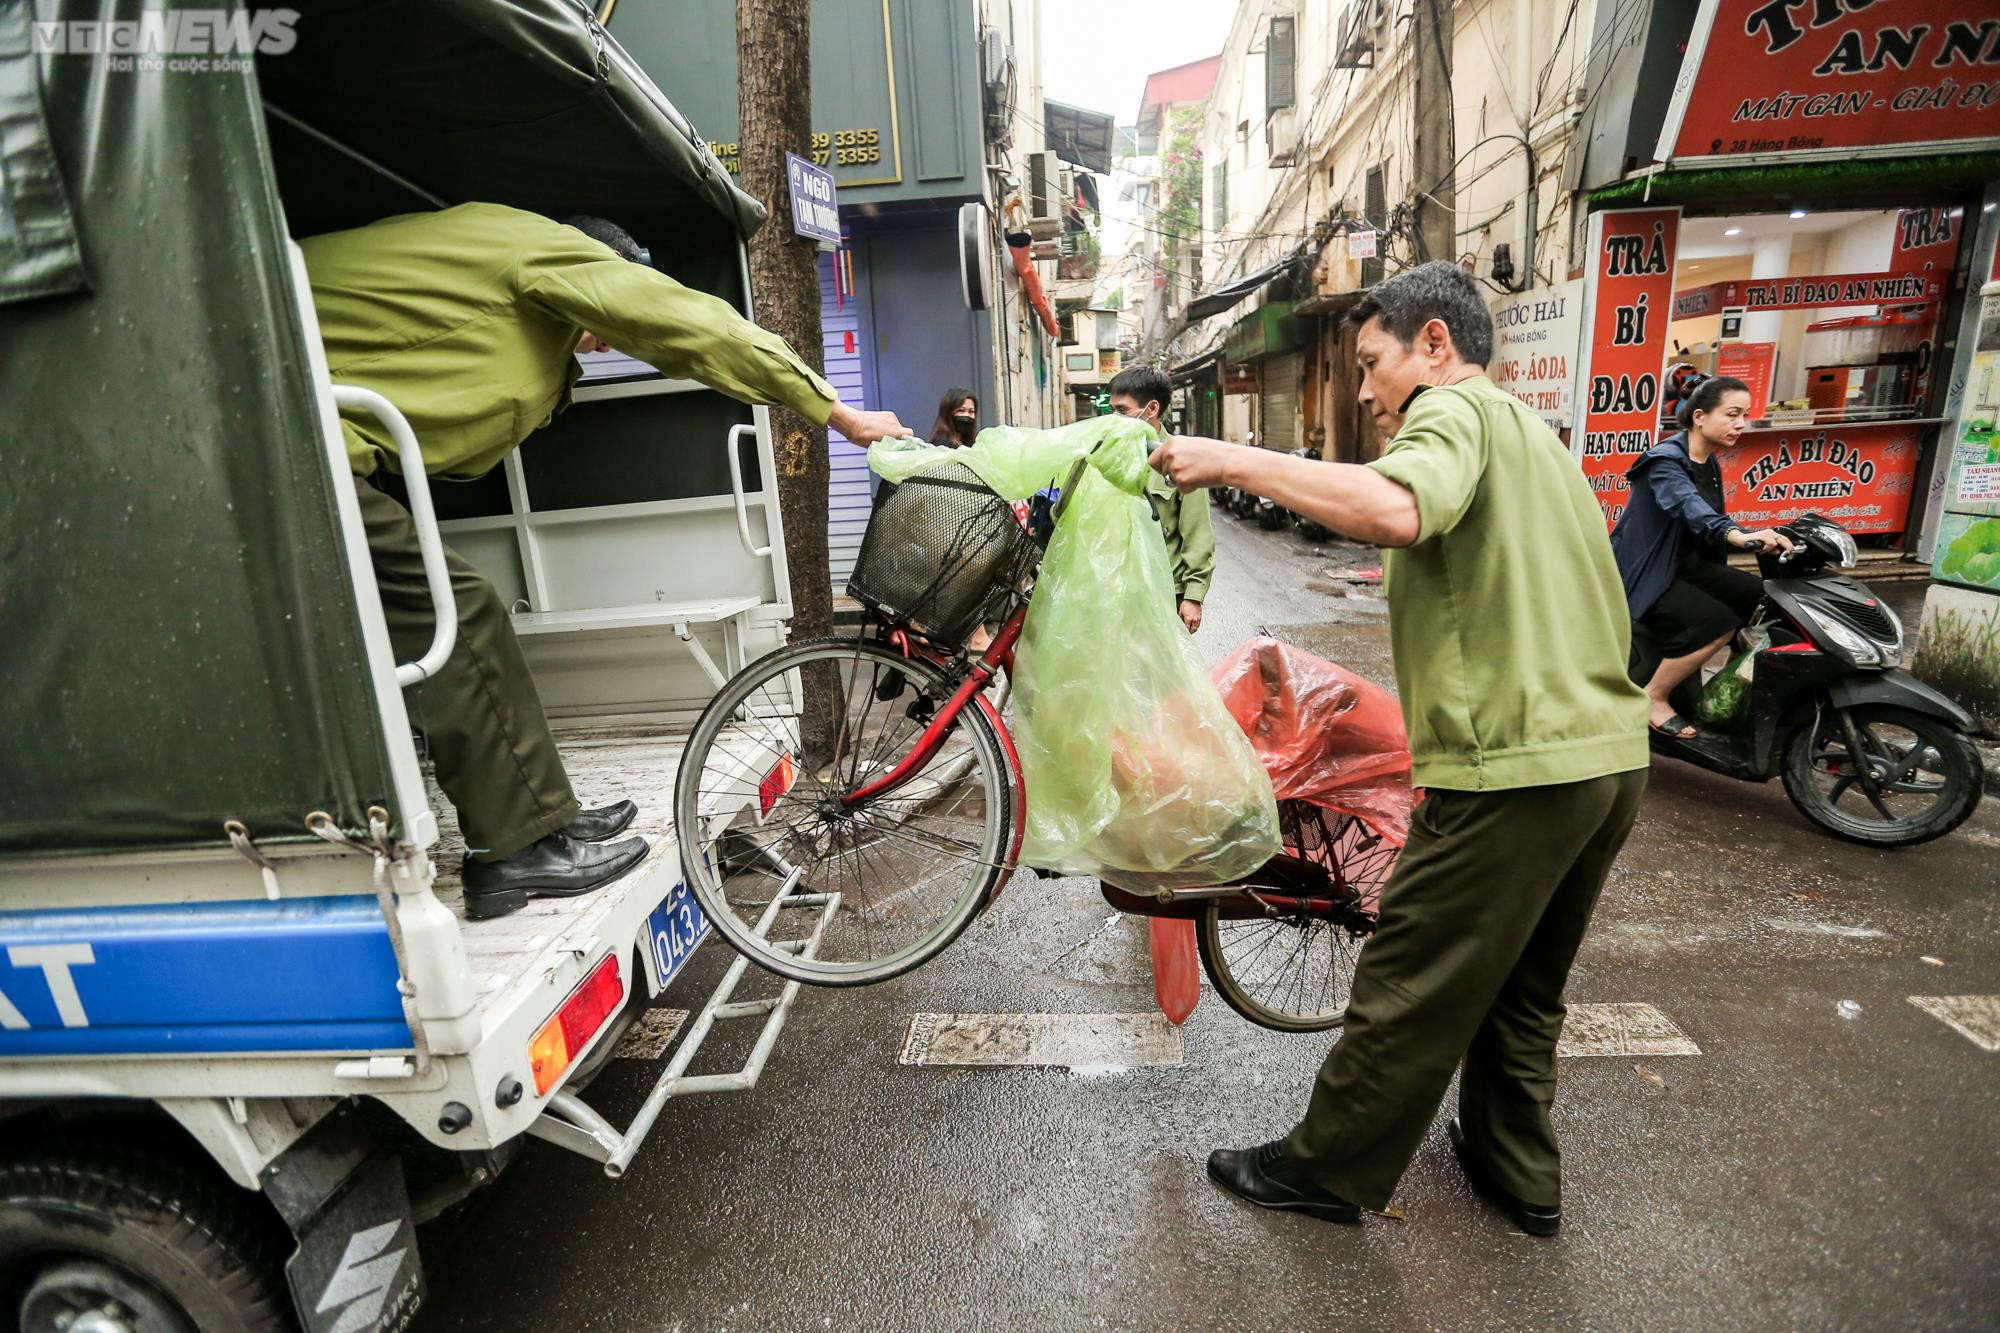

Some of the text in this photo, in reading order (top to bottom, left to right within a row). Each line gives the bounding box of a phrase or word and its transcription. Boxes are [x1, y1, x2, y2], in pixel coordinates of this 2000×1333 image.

[1812, 28, 1930, 76] AN
[1732, 92, 1804, 122] MÁT
[1802, 91, 1873, 119] GAN
[834, 128, 879, 147] 3355
[836, 147, 882, 167] 3355
[802, 171, 831, 203] NGÕ
[1605, 220, 1668, 277] TRÀ
[1746, 272, 1926, 307] TRÀ BÍ ĐAO AN NHIÊN
[1612, 293, 1649, 346] BÍ
[1591, 373, 1657, 414] ĐAO
[1584, 430, 1651, 461] HẠT CHIA
[1742, 431, 1876, 491] TRÀ BÍ ĐAO
[1588, 471, 1616, 493] MÁT
[1758, 478, 1854, 501] AN NHIÊN
[0, 942, 96, 1030] T
